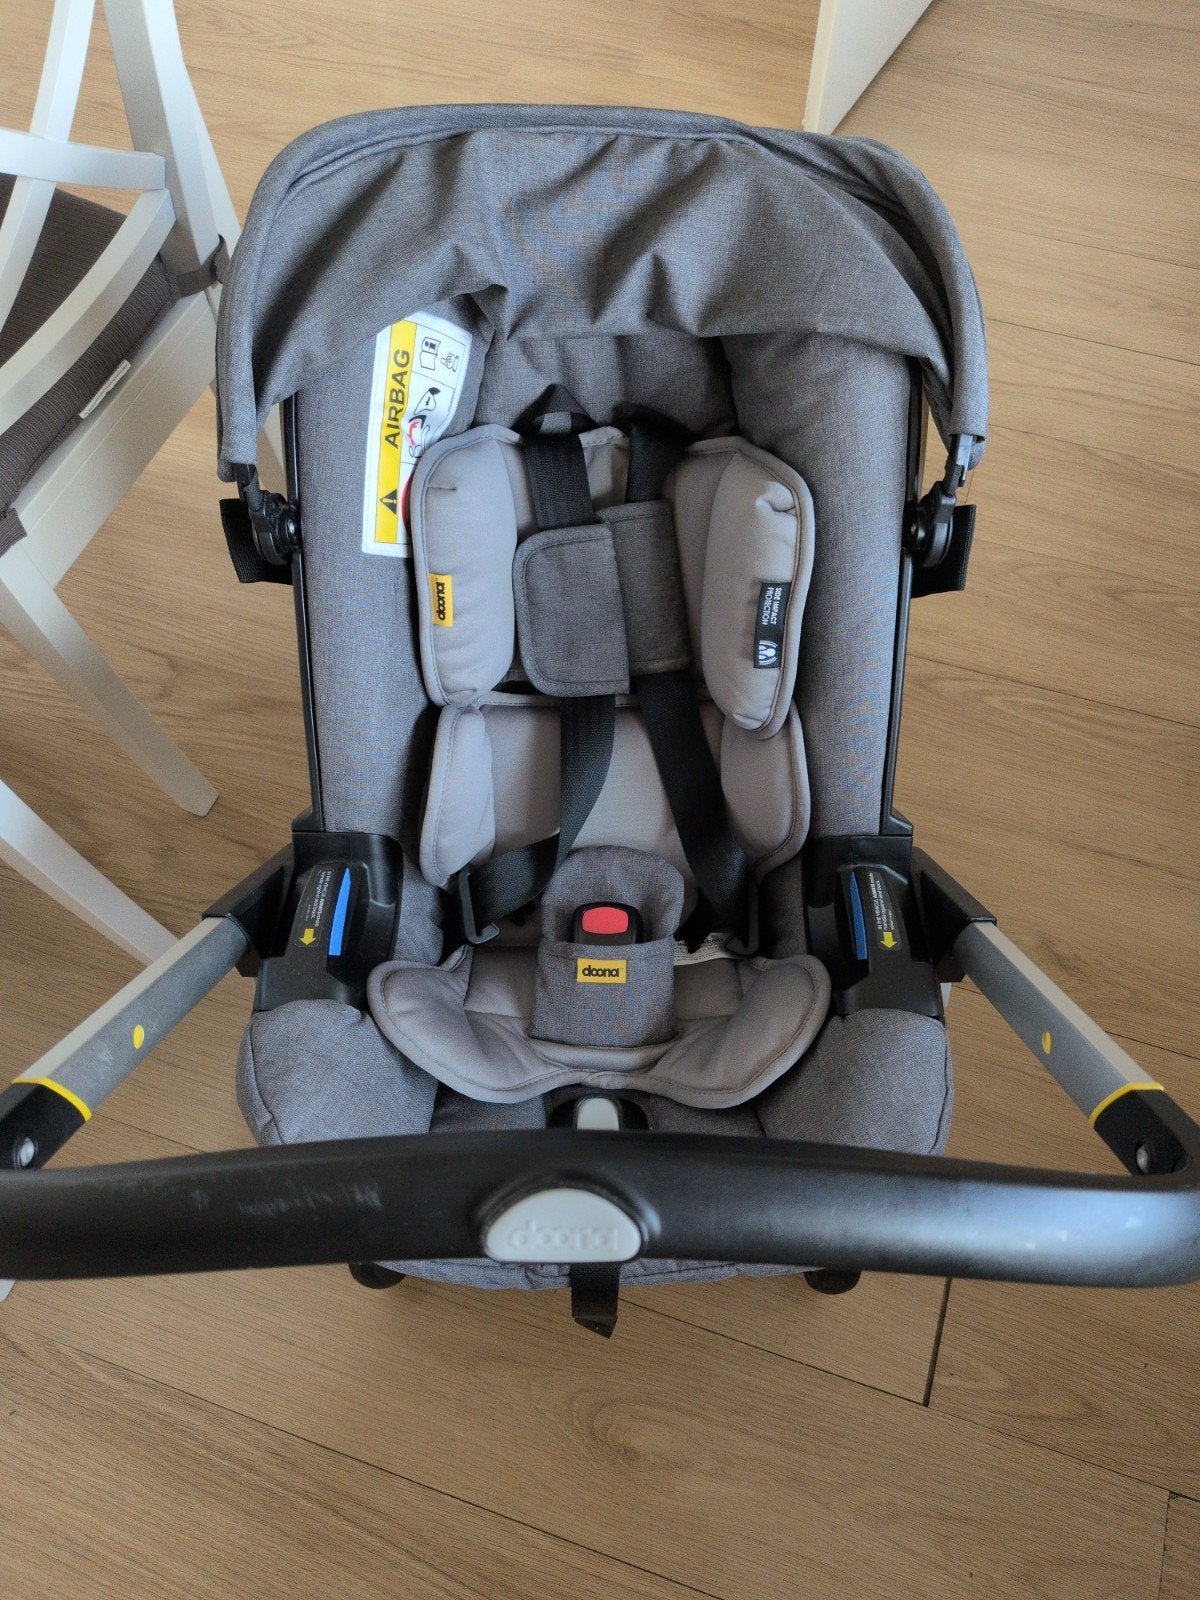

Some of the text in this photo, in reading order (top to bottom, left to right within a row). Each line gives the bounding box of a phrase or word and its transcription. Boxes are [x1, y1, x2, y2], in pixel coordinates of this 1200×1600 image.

[384, 349, 411, 449] AIRBAG
[435, 581, 446, 621] doona
[762, 587, 774, 625] PROTECTION
[770, 587, 782, 625] SIDE IMPACT
[582, 964, 620, 978] doona
[508, 1219, 619, 1251] doona
